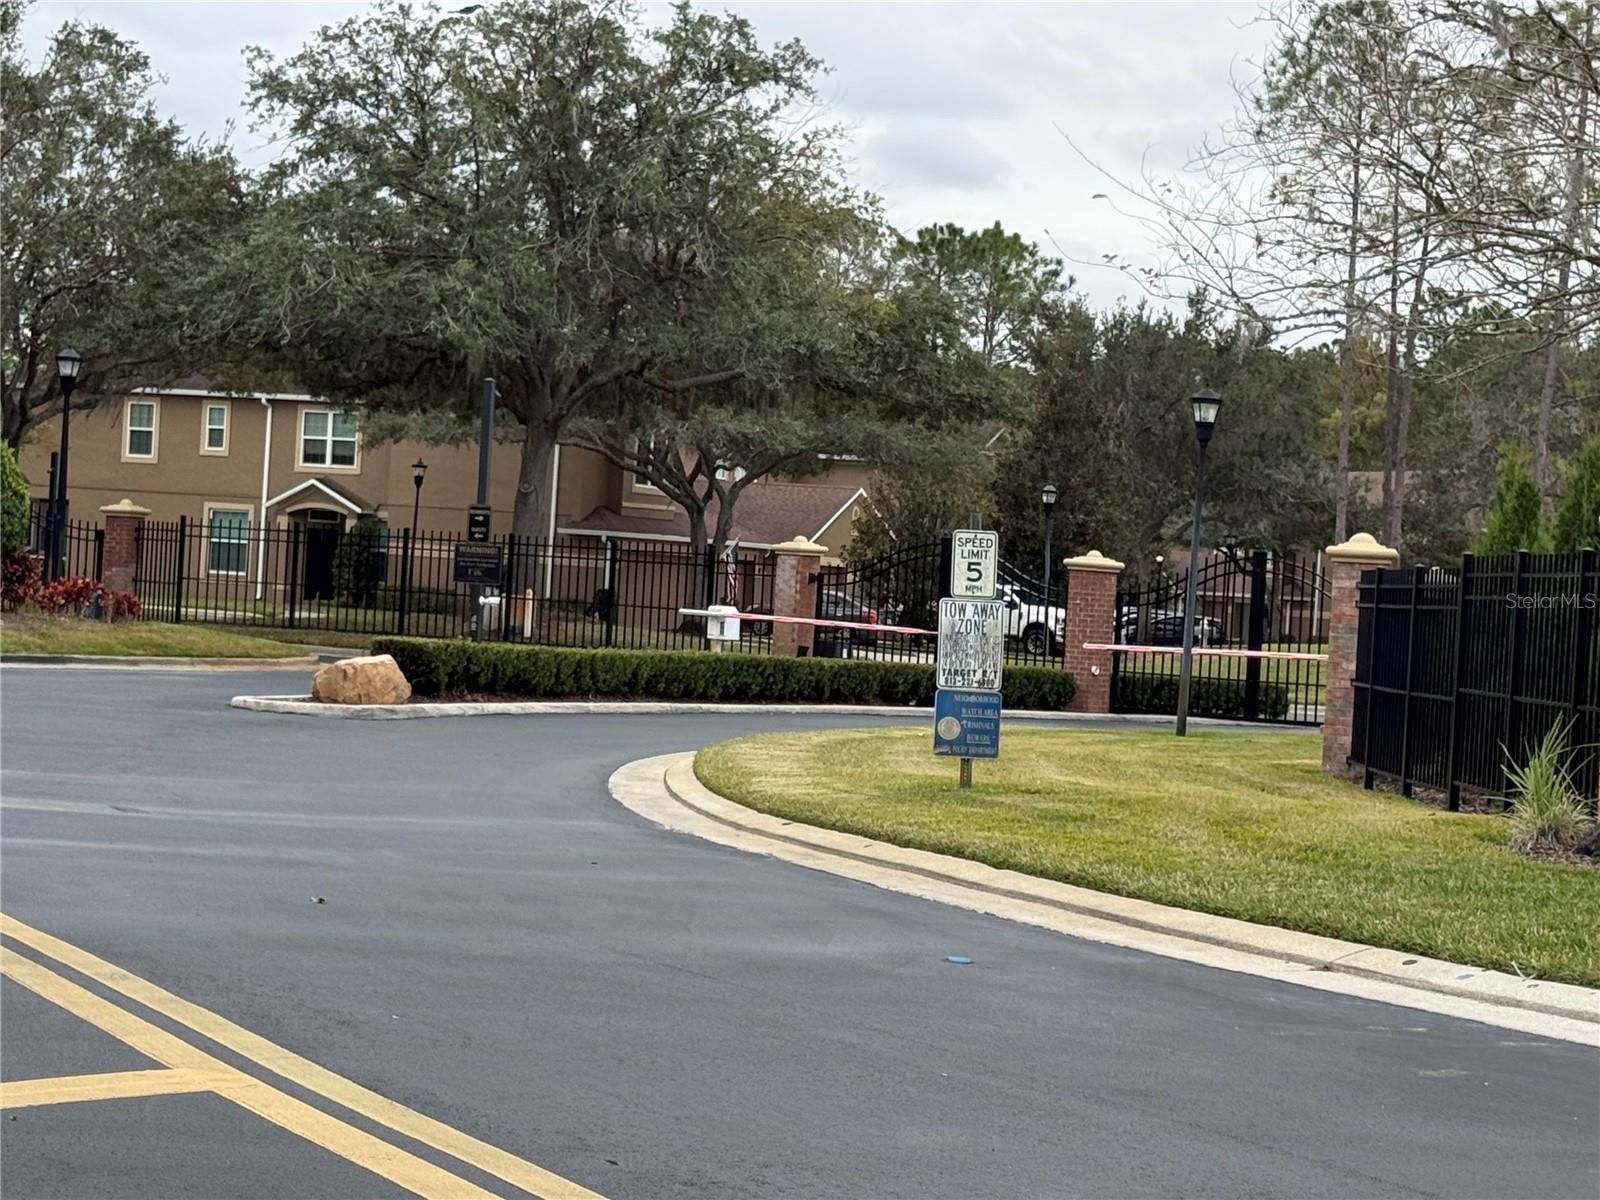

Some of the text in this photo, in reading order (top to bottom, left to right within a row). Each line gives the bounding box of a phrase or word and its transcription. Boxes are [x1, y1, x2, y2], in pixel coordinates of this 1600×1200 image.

[957, 537, 993, 548] SPEED
[961, 549, 990, 560] LIMIT
[966, 561, 983, 582] 5
[965, 585, 982, 594] MPH
[944, 602, 1000, 620] TOW AWAY
[957, 618, 987, 636] ZONE
[942, 668, 977, 678] TARGET
